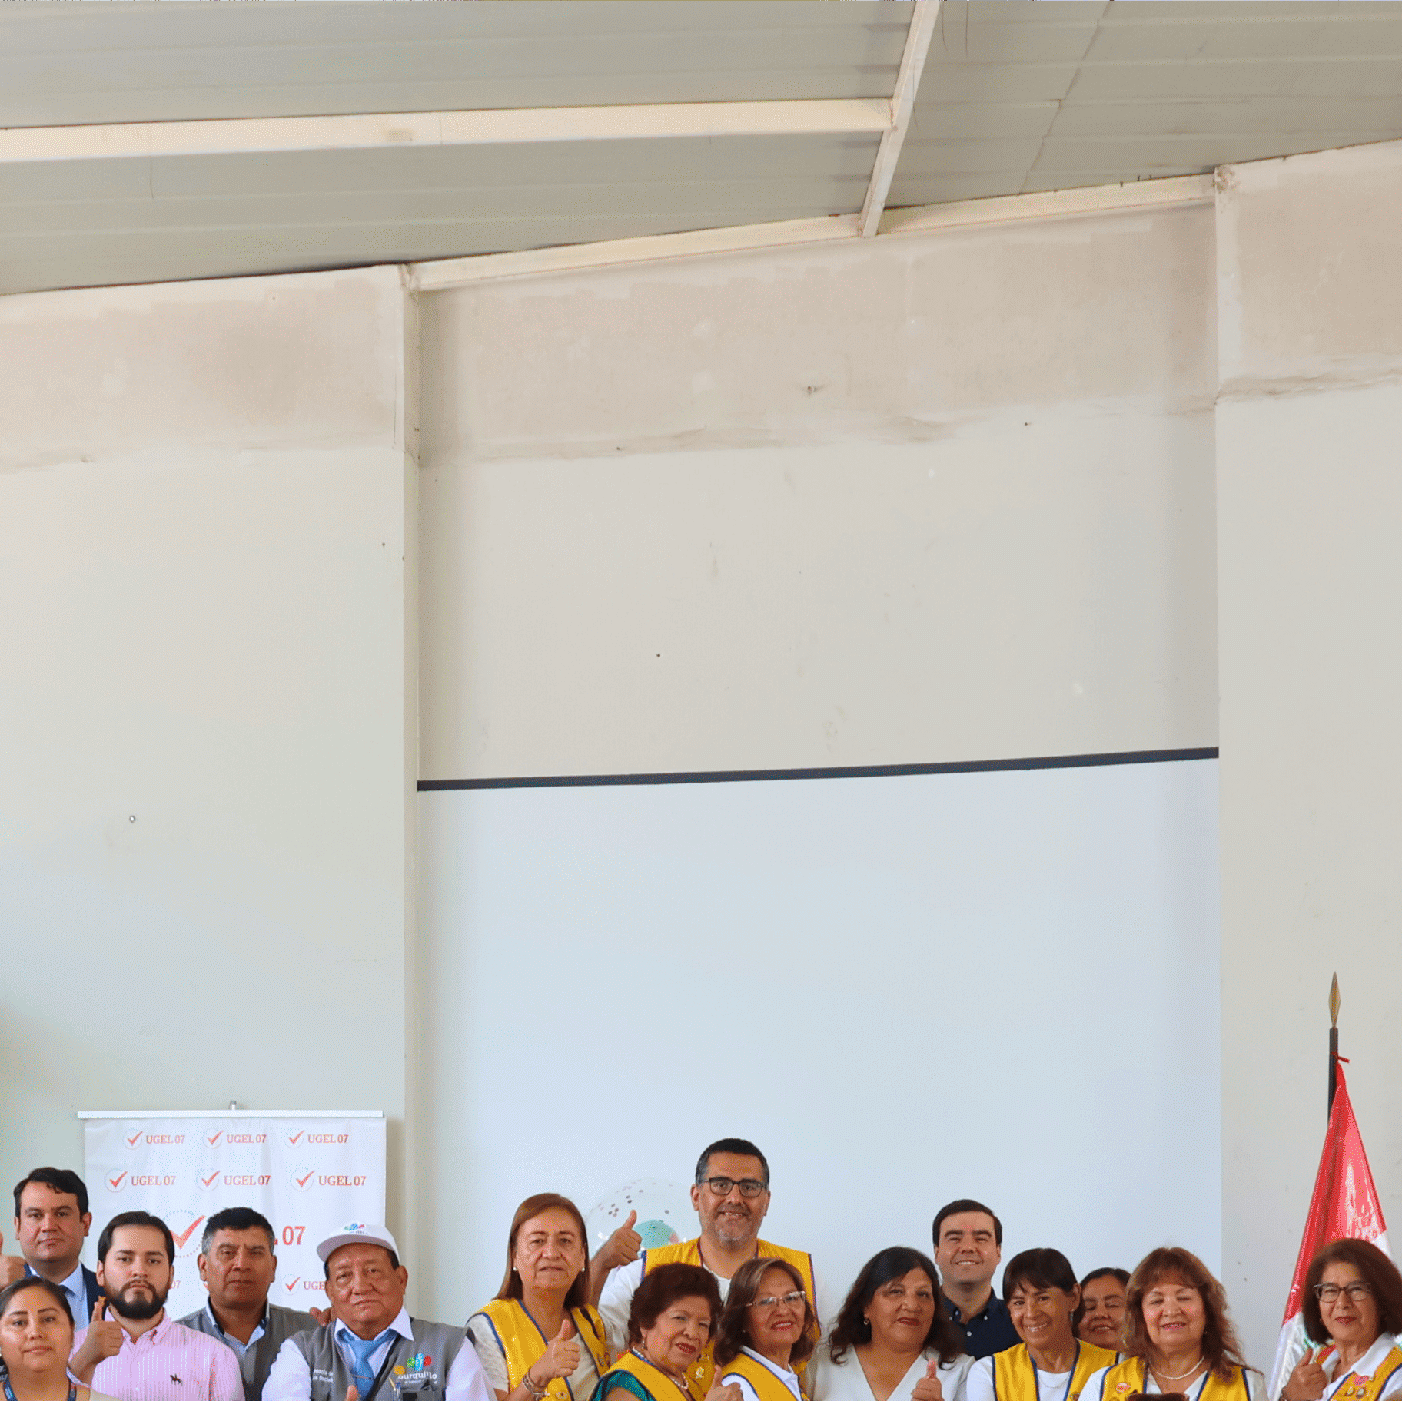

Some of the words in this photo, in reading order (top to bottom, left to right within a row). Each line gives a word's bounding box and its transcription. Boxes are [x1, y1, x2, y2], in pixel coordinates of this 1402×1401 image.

[146, 1134, 174, 1144] UGEL
[174, 1134, 185, 1144] 07
[226, 1133, 254, 1144] UGEL
[255, 1133, 267, 1144] 07
[307, 1133, 336, 1144] UGEL
[336, 1133, 349, 1144] 07
[130, 1175, 162, 1186] UGEL
[163, 1175, 176, 1186] 07
[223, 1175, 256, 1186] UGEL
[257, 1175, 271, 1186] 07
[318, 1175, 352, 1186] UGEL
[353, 1175, 366, 1186] 07
[282, 1226, 306, 1246] 07
[303, 1281, 326, 1290] UGE
